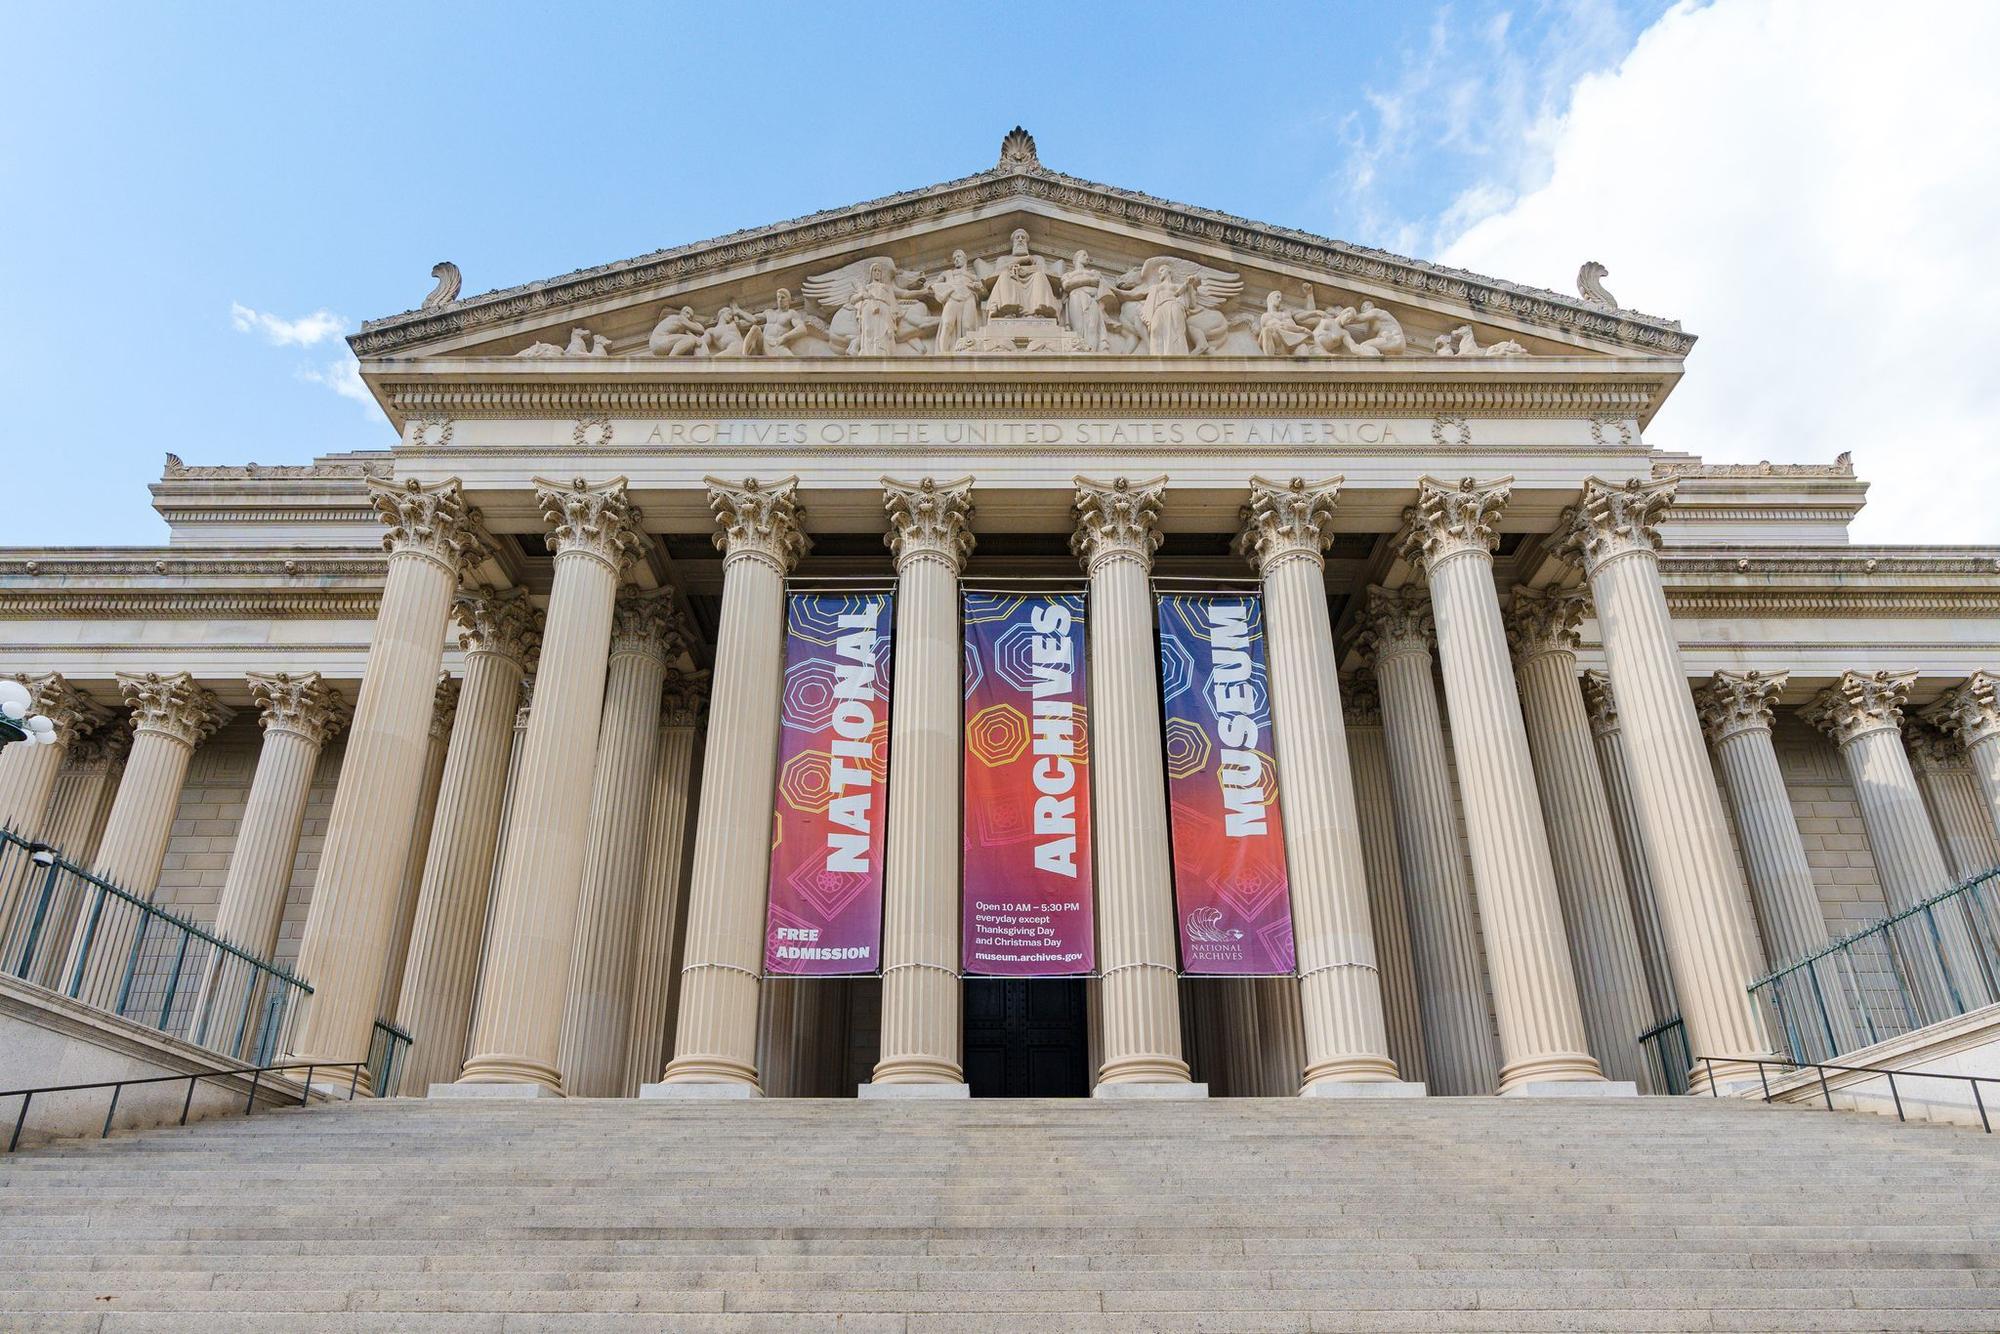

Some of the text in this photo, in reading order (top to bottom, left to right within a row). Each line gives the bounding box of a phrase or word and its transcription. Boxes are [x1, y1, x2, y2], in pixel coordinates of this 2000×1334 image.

[647, 423, 1400, 444] ARCHIVES OF THE UNITED STATES OF AMERICA
[1207, 605, 1269, 837] MUSEUM
[826, 603, 878, 873] NATIONAL
[1030, 604, 1078, 878] ARCHIVES
[975, 901, 1000, 912] Open
[1002, 903, 1014, 912] 10
[1015, 903, 1031, 912] AM
[1041, 903, 1062, 912] 5:30
[1064, 902, 1080, 911] PM
[976, 914, 1050, 924] everyday except
[777, 927, 819, 941] FREE
[976, 924, 1055, 937] Thanksgiving Day
[975, 936, 1061, 947] and Christmas Day
[1191, 944, 1242, 952] NATIONAL
[776, 946, 870, 960] ADMISSION
[975, 952, 1082, 962] museum.archives.gov
[1191, 952, 1243, 960] ARCHIVES
